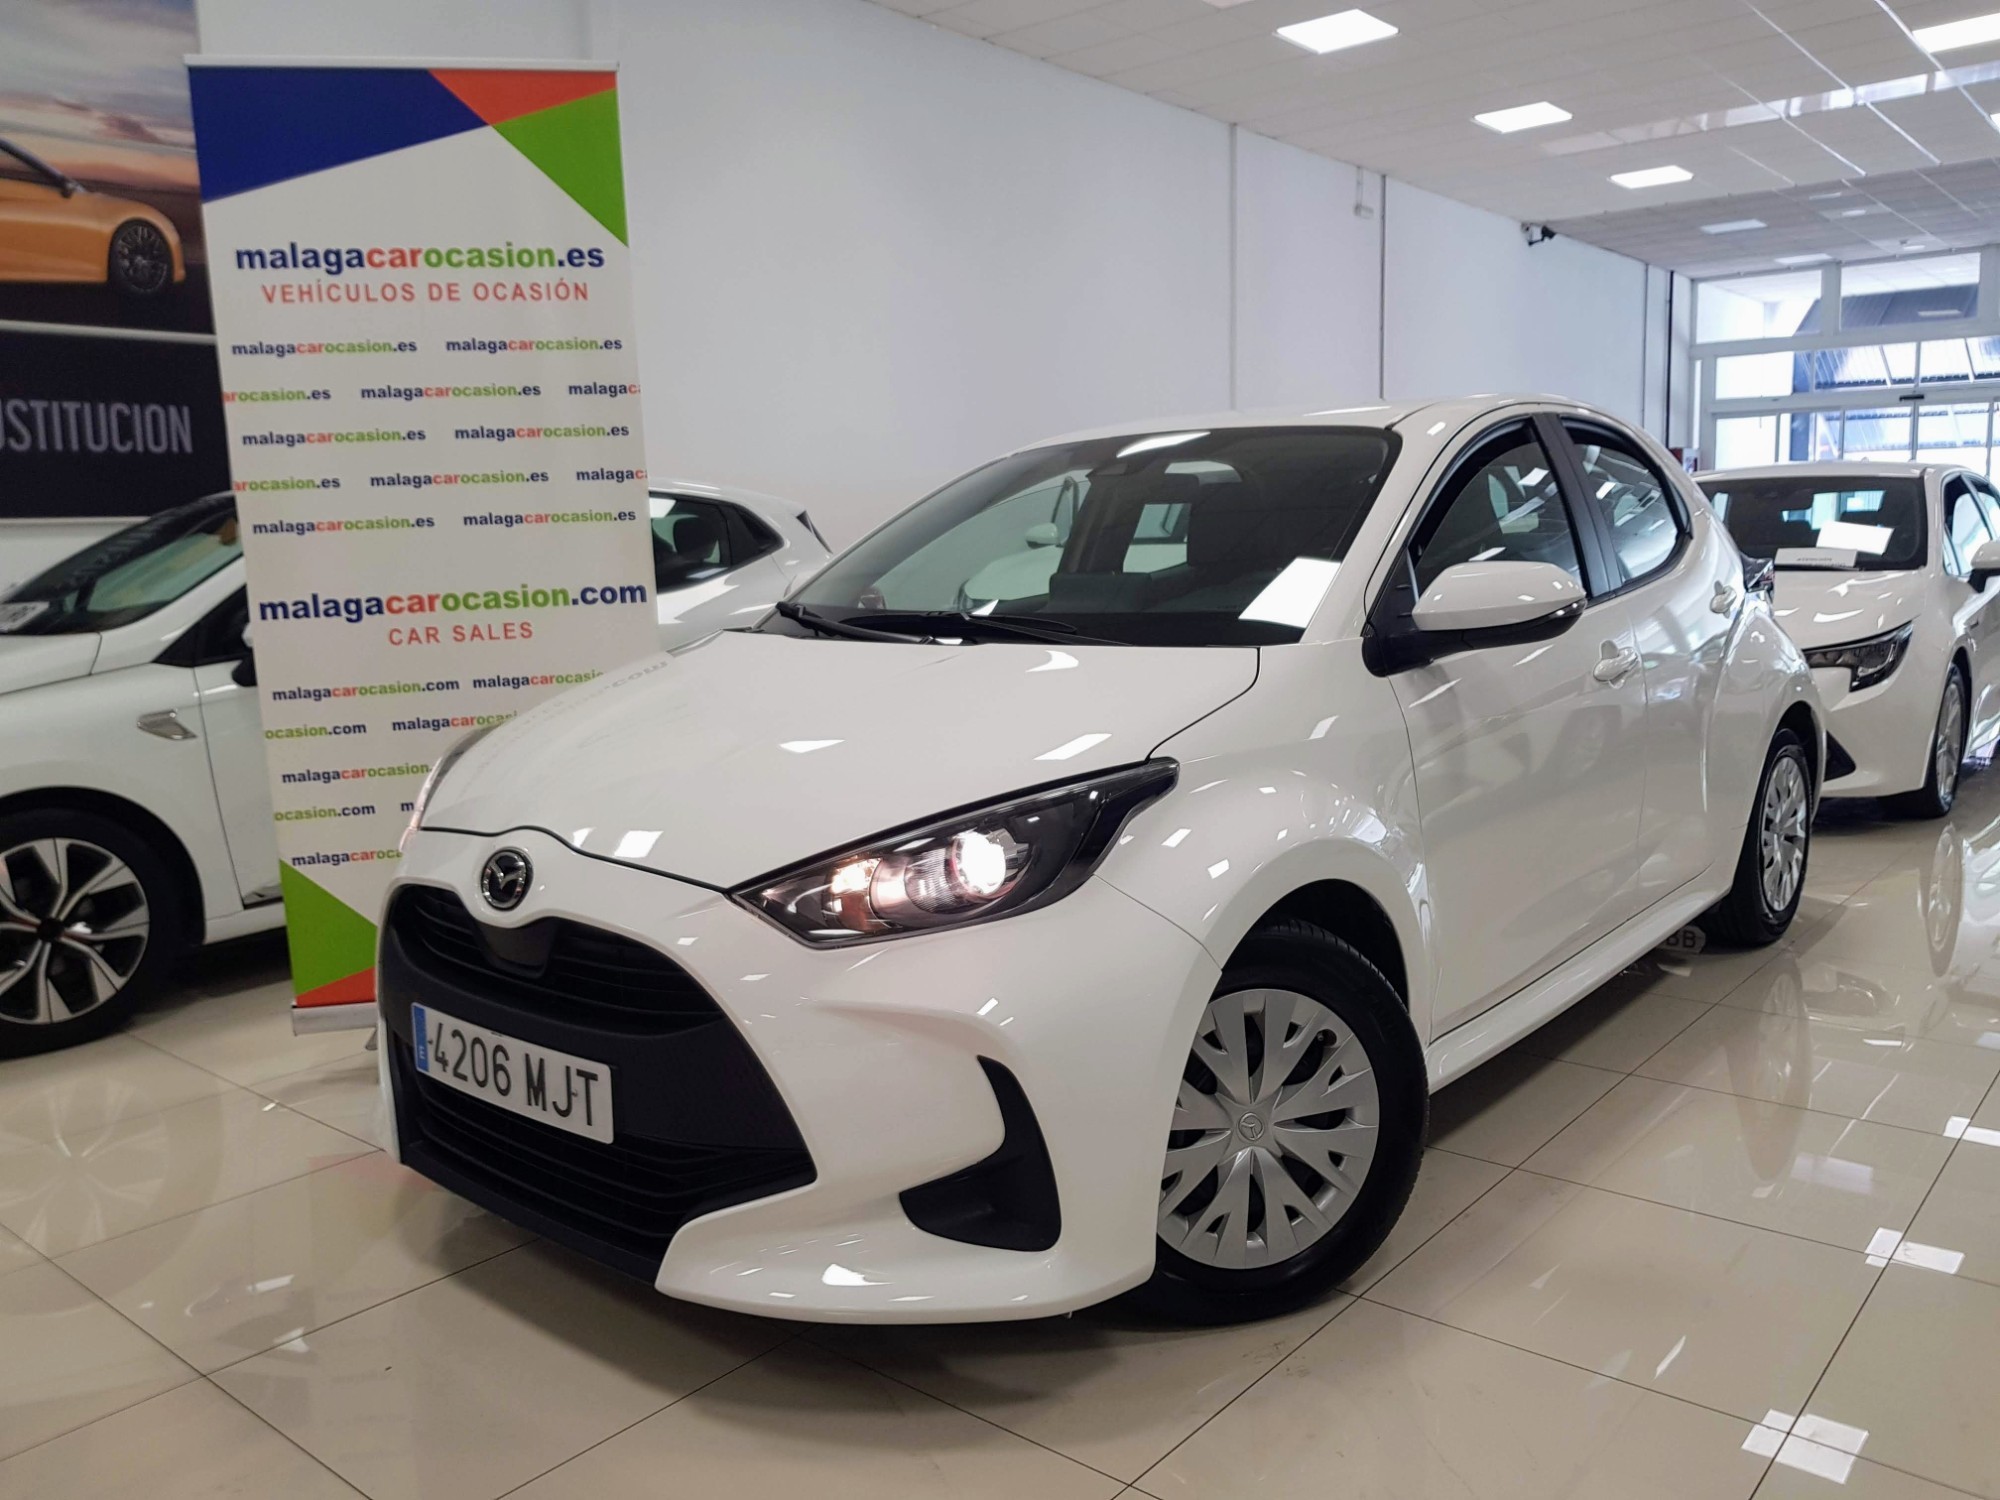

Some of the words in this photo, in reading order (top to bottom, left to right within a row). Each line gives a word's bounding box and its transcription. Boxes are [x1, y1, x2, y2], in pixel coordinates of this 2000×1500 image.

[235, 240, 605, 275] malagacarocasion.es
[262, 278, 416, 303] VEHÍCULOS
[428, 282, 461, 302] DE
[473, 277, 589, 301] OCASIÓN
[232, 339, 417, 358] malagacarocasion.es
[446, 336, 622, 354] malagacarocasion.es
[361, 382, 541, 401] malagacarocasion.es
[0, 398, 193, 454] STITUCION
[242, 428, 426, 447] malagacarocasion.es
[455, 424, 629, 442] malagacarocasion.es
[370, 470, 549, 488] malagacarocasion.es
[253, 516, 435, 536] malagacarocasion.es
[463, 509, 636, 528] malagacarocasion.es
[258, 582, 647, 624] malagacarocasion.com
[388, 626, 441, 646] CAR
[452, 622, 533, 643] SALES
[272, 680, 460, 701] malagacarocasion.com
[435, 1022, 511, 1097] 4206
[525, 1052, 598, 1127] MJT
